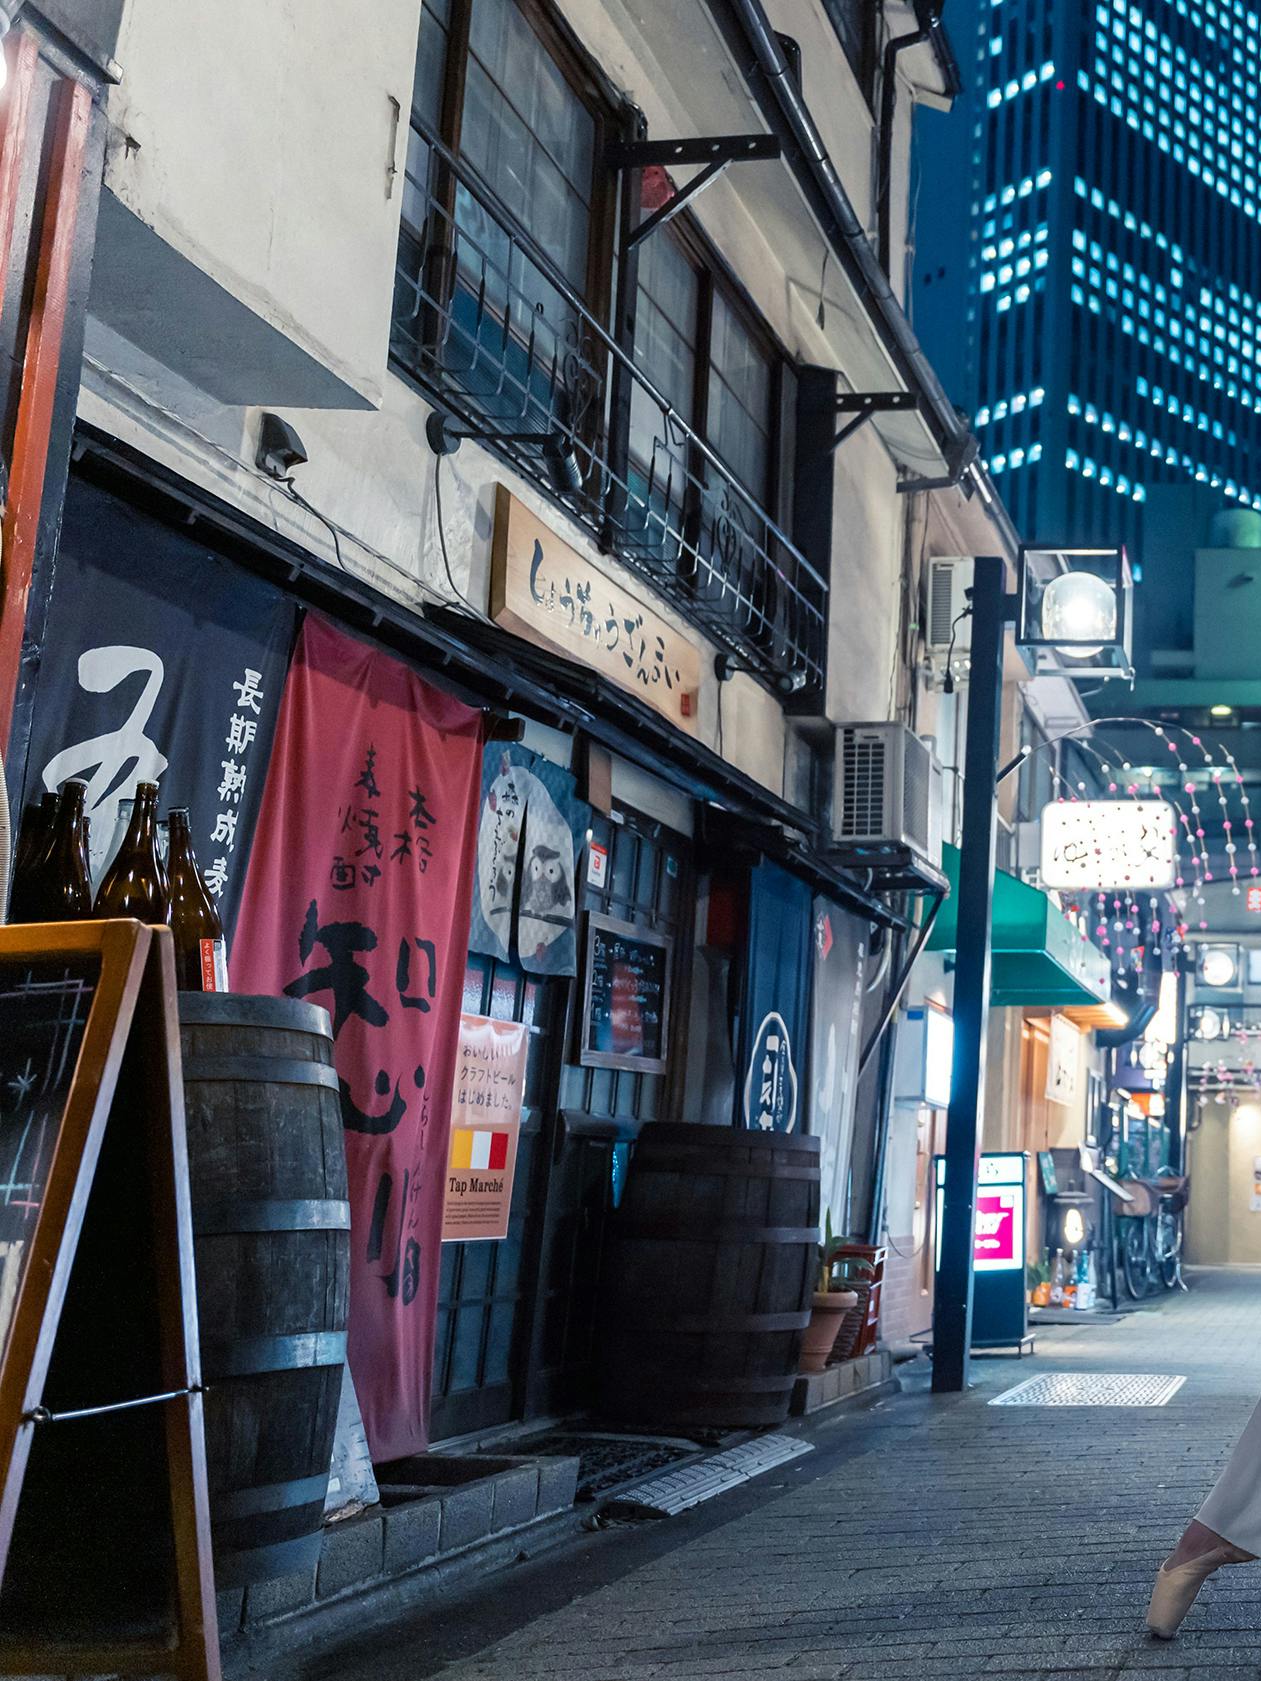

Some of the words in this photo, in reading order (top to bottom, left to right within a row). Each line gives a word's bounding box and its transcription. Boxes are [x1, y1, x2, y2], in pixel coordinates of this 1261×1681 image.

[461, 1065, 516, 1086] クラフトビール
[449, 1178, 467, 1196] Tap
[469, 1178, 504, 1193] Marché
